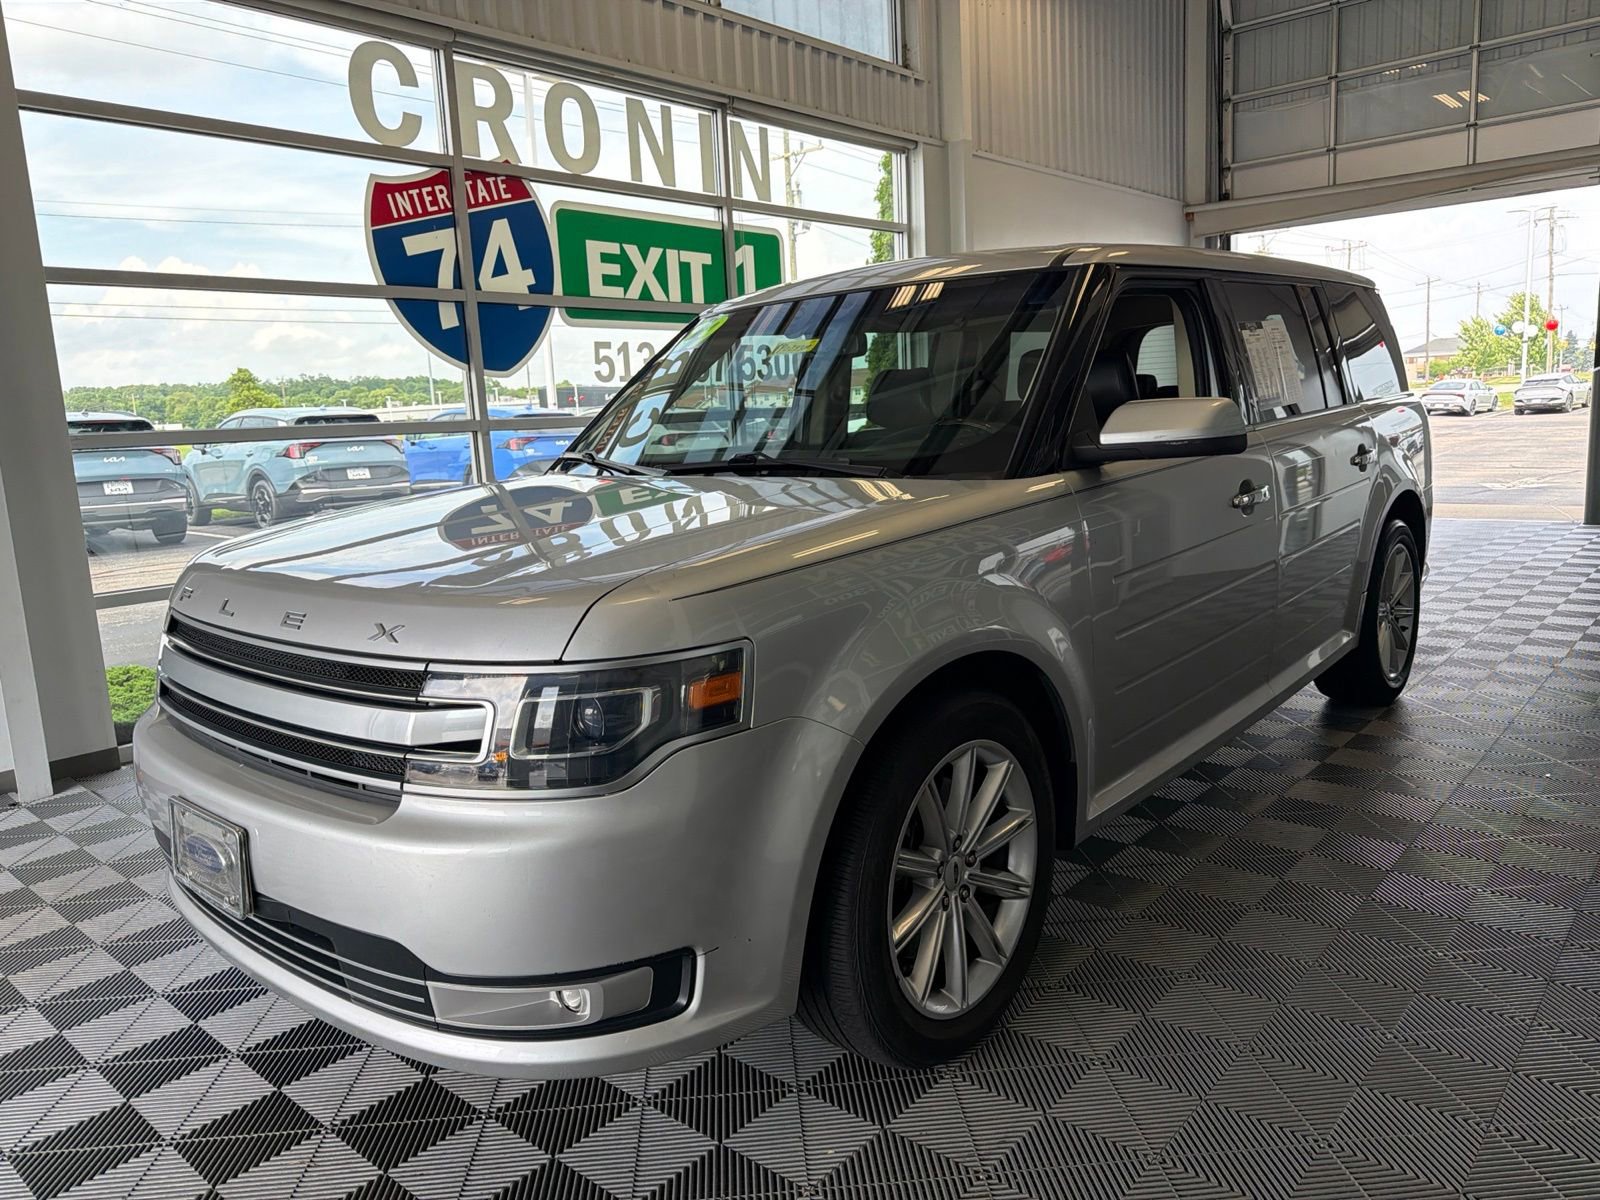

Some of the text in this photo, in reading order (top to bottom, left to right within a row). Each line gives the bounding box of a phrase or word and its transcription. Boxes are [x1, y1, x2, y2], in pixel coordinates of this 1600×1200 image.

[348, 41, 772, 202] CRONIN
[386, 176, 512, 219] INTERTATE
[401, 217, 536, 330] 74
[585, 239, 757, 304] EXIT 1
[179, 586, 405, 644] FLEX
